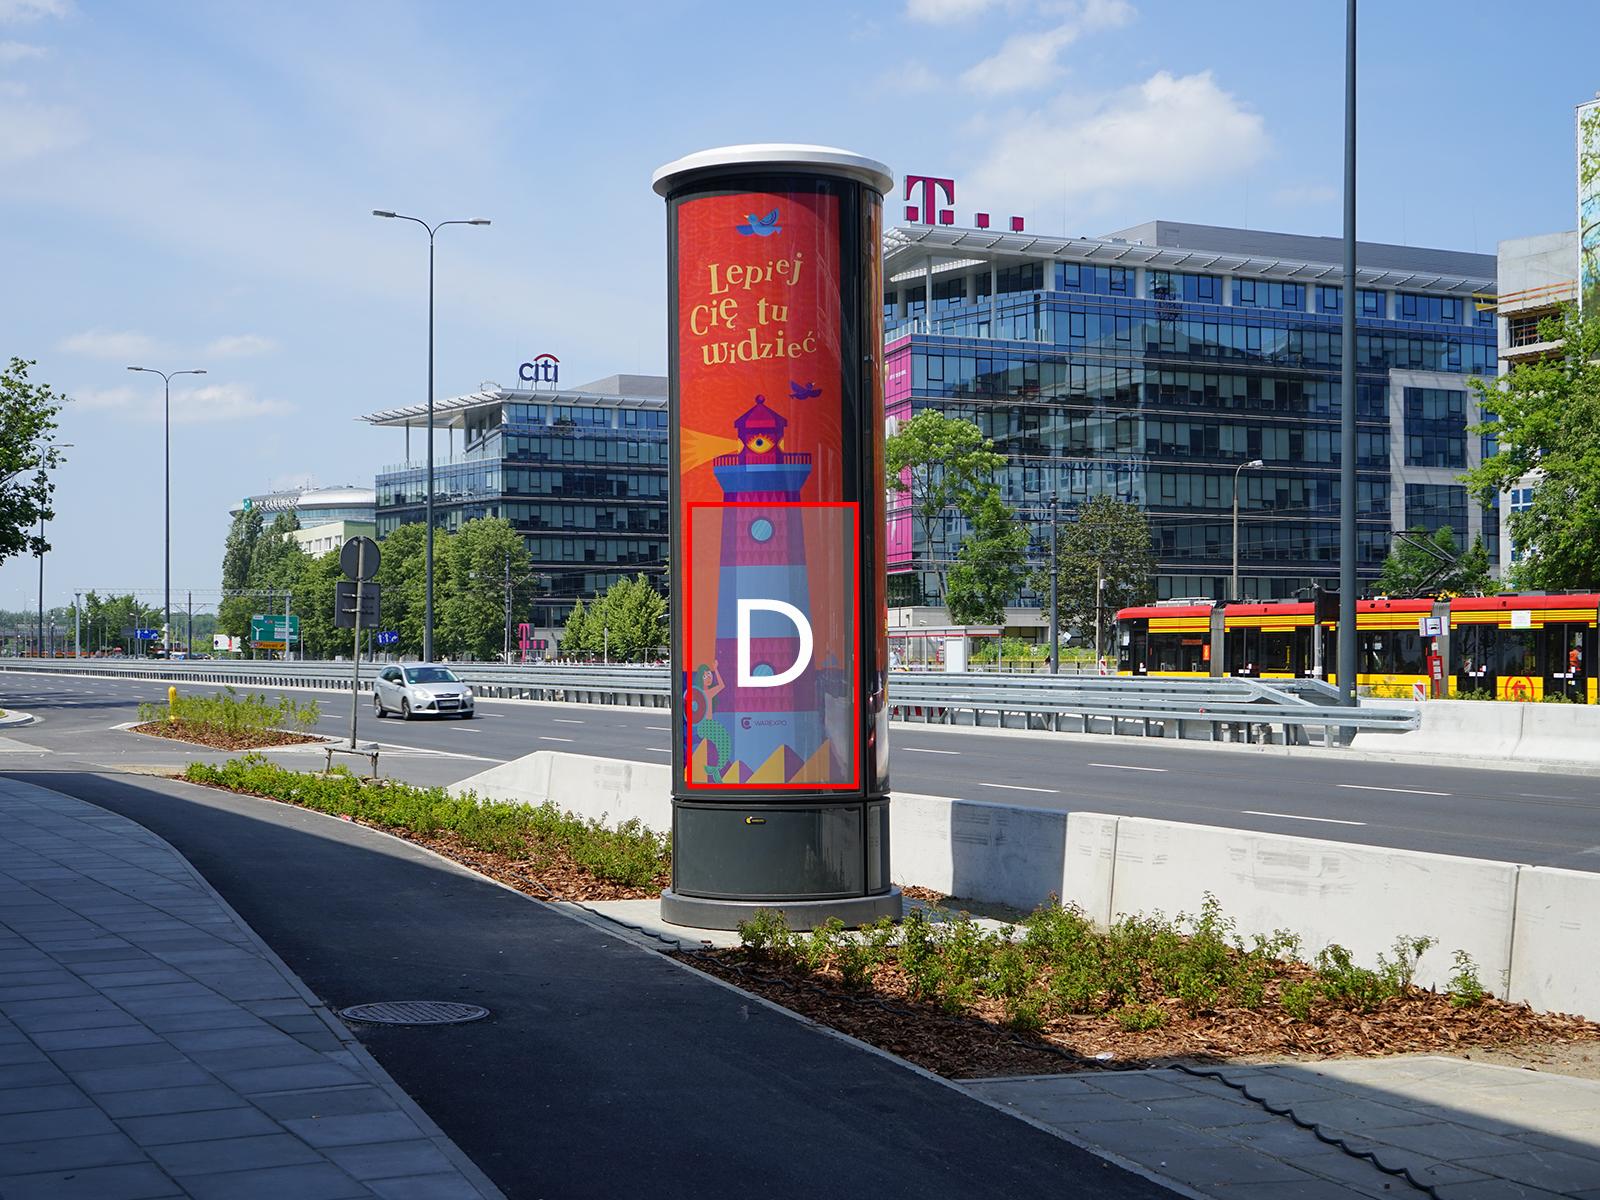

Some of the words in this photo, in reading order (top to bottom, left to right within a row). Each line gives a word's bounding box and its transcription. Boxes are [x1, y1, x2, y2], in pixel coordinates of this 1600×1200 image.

[903, 175, 955, 226] T
[708, 252, 803, 295] Lepiej
[690, 297, 738, 336] Cię
[756, 297, 788, 325] tu
[701, 327, 817, 366] widzieć
[518, 359, 559, 383] citi
